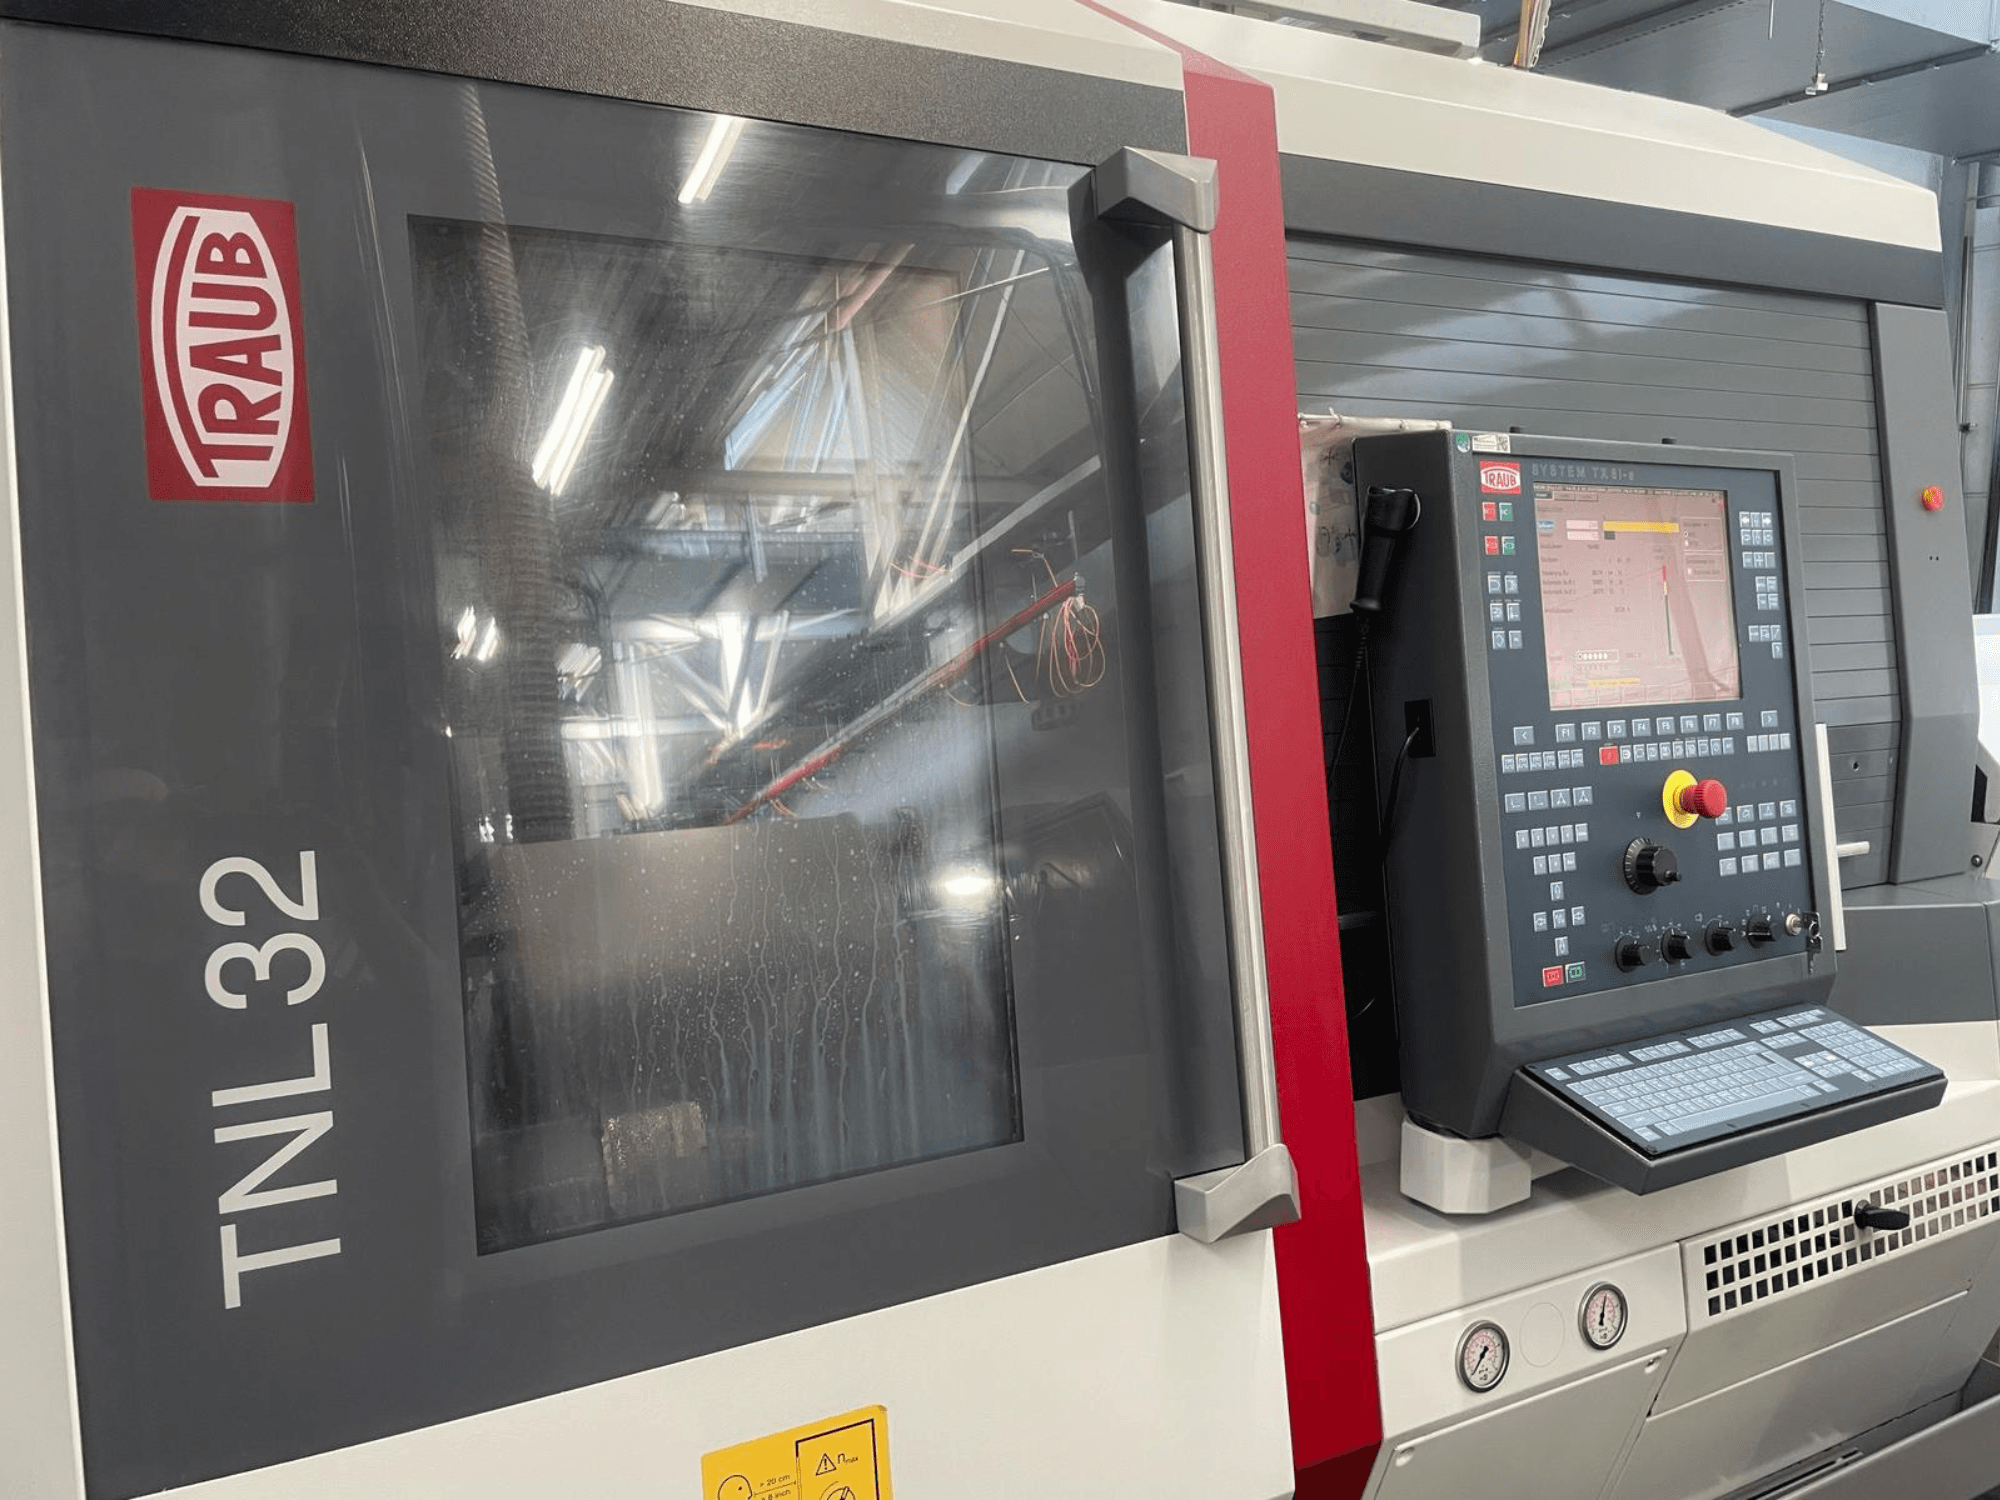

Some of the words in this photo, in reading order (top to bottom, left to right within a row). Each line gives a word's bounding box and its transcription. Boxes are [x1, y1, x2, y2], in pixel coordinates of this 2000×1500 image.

[163, 215, 283, 478] TRAUB
[1482, 467, 1518, 487] TRAUB
[1532, 463, 1586, 478] SYSTEM
[199, 850, 327, 1009] 32
[212, 1022, 341, 1309] TNL
[766, 1477, 777, 1486] 20
[778, 1475, 790, 1483] cm
